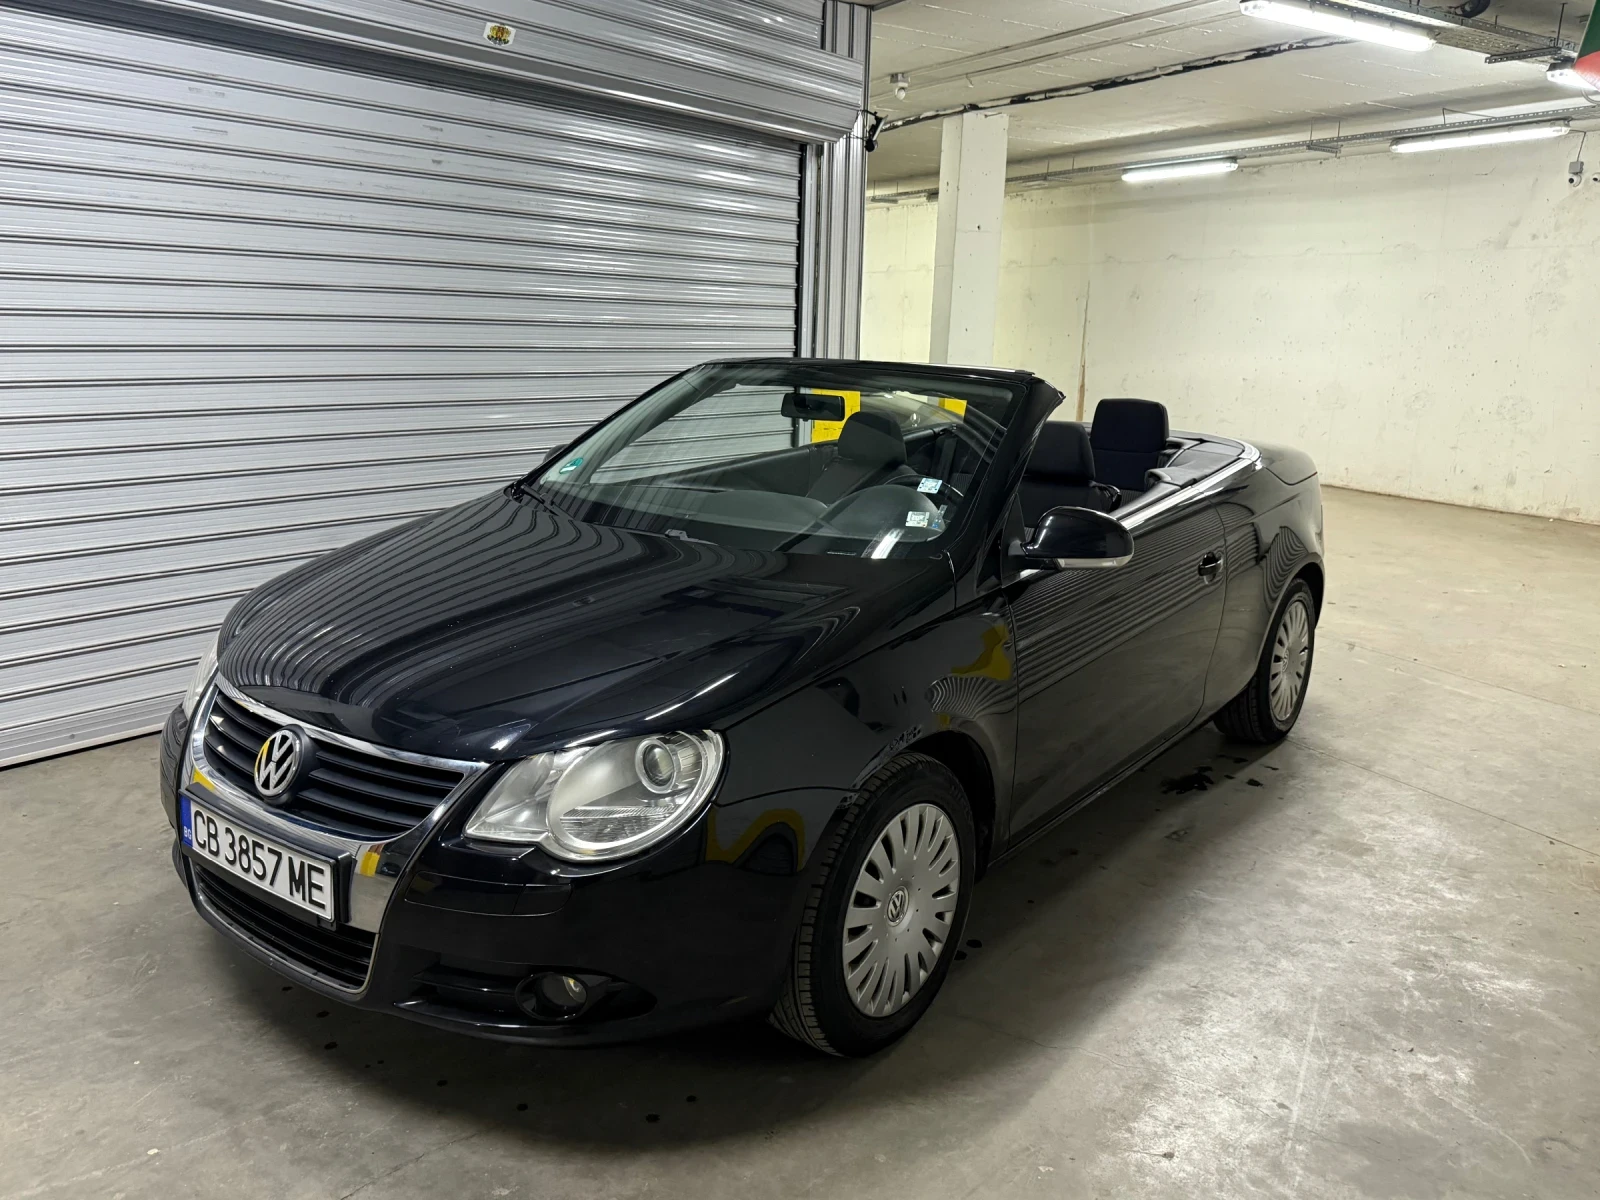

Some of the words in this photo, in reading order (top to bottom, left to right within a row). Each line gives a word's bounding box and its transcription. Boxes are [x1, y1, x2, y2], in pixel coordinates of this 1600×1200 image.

[183, 826, 192, 840] BG
[194, 810, 220, 857] CB
[224, 827, 283, 886] 3857
[288, 856, 326, 910] ME
